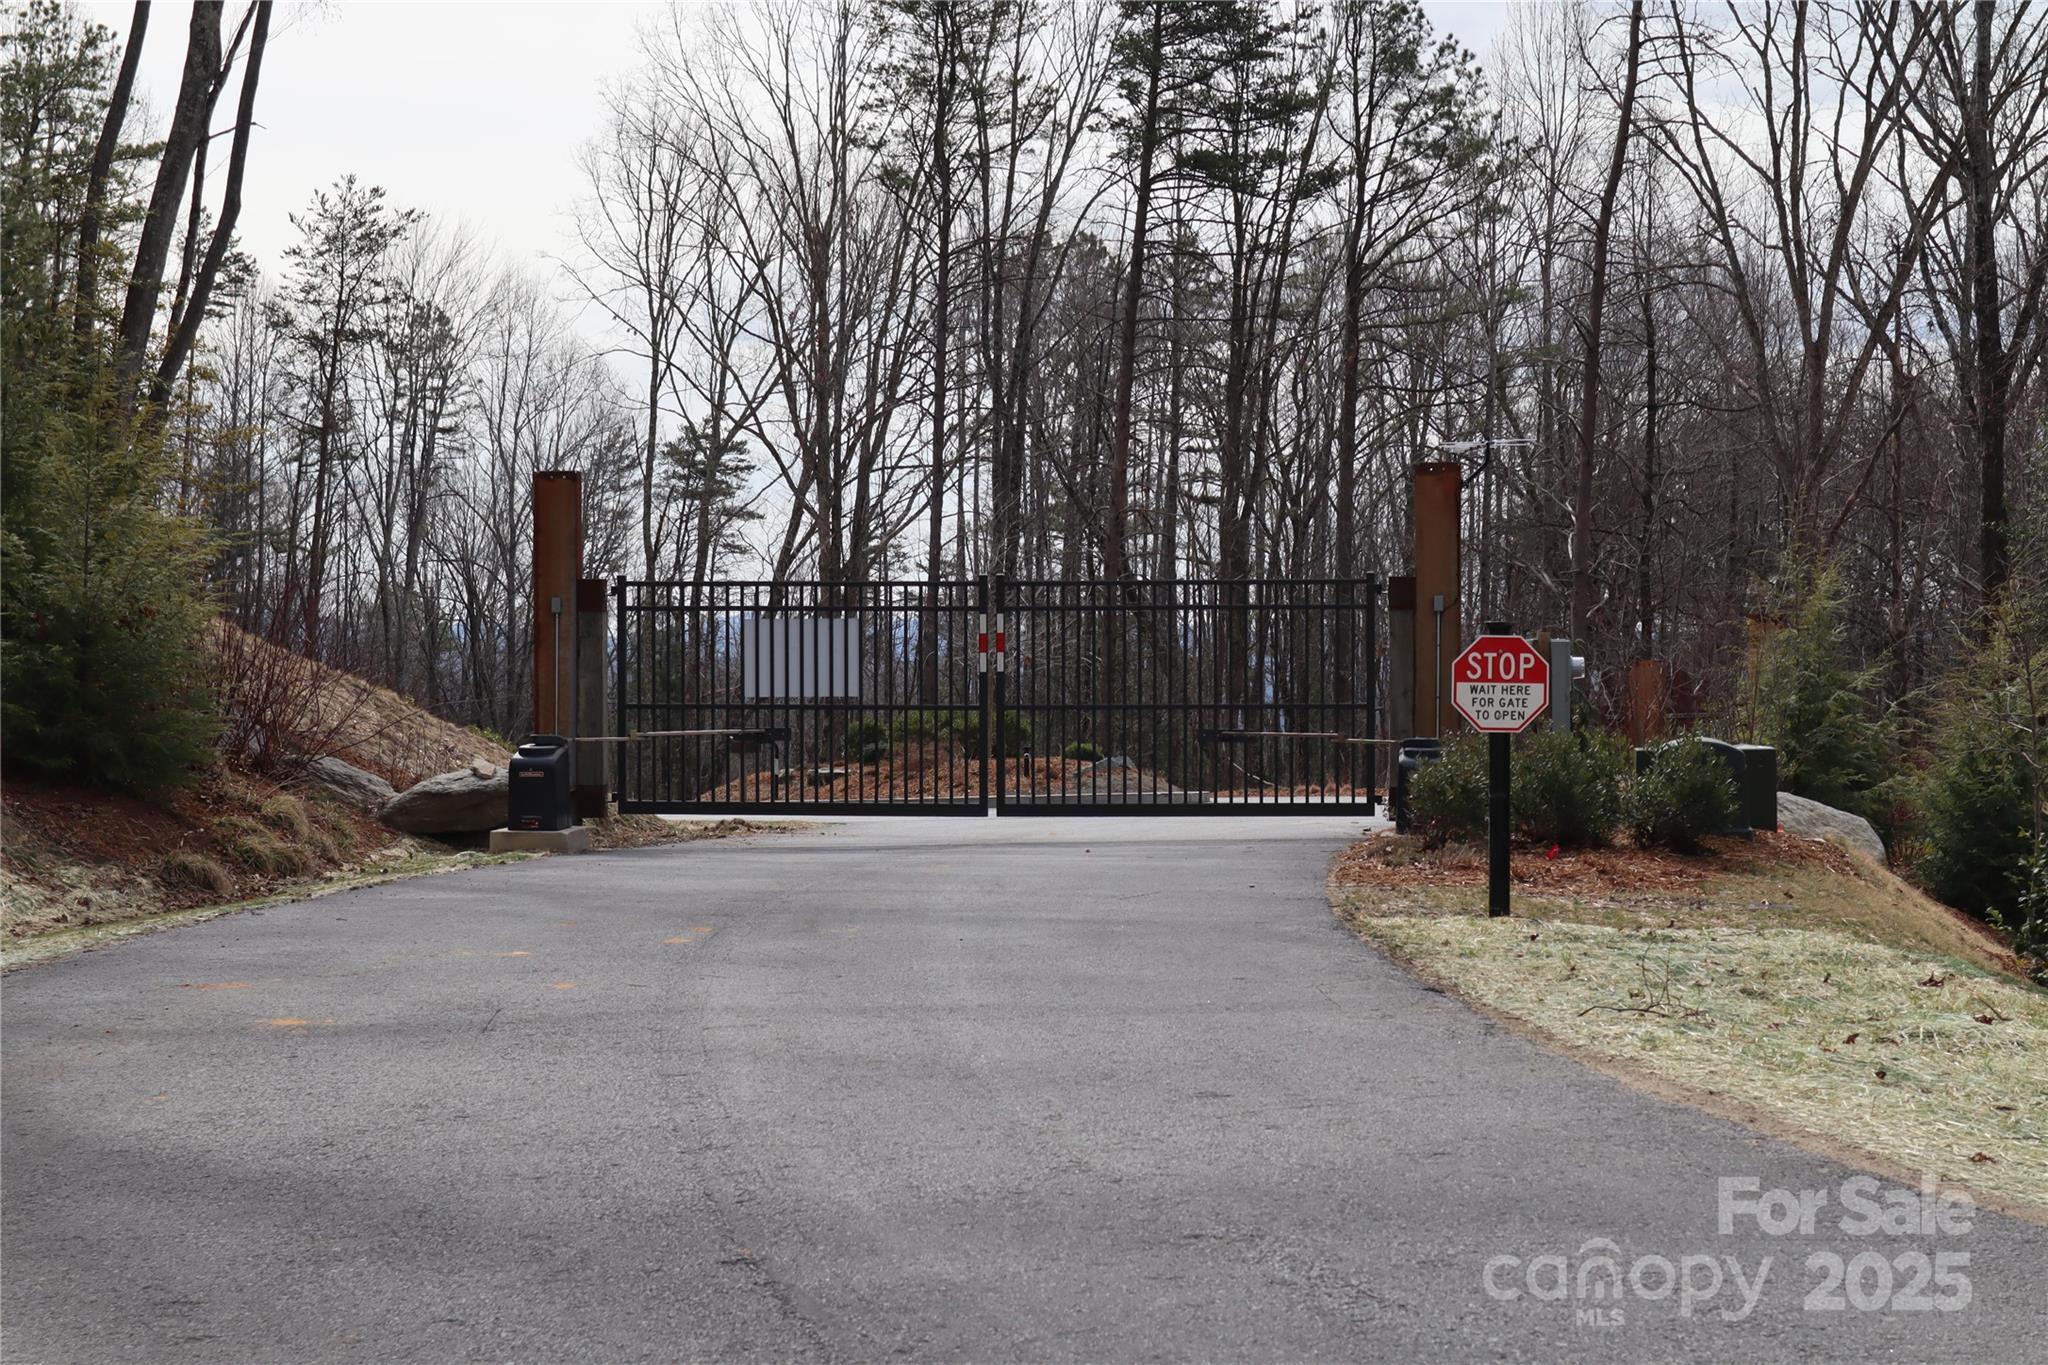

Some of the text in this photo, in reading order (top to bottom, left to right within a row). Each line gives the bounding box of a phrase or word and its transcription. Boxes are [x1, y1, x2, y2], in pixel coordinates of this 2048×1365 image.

[1466, 651, 1535, 680] STOP
[1470, 685, 1531, 695] WAIT HERE
[1472, 698, 1528, 708] FOR GATE
[1476, 710, 1525, 720] TO OPEN
